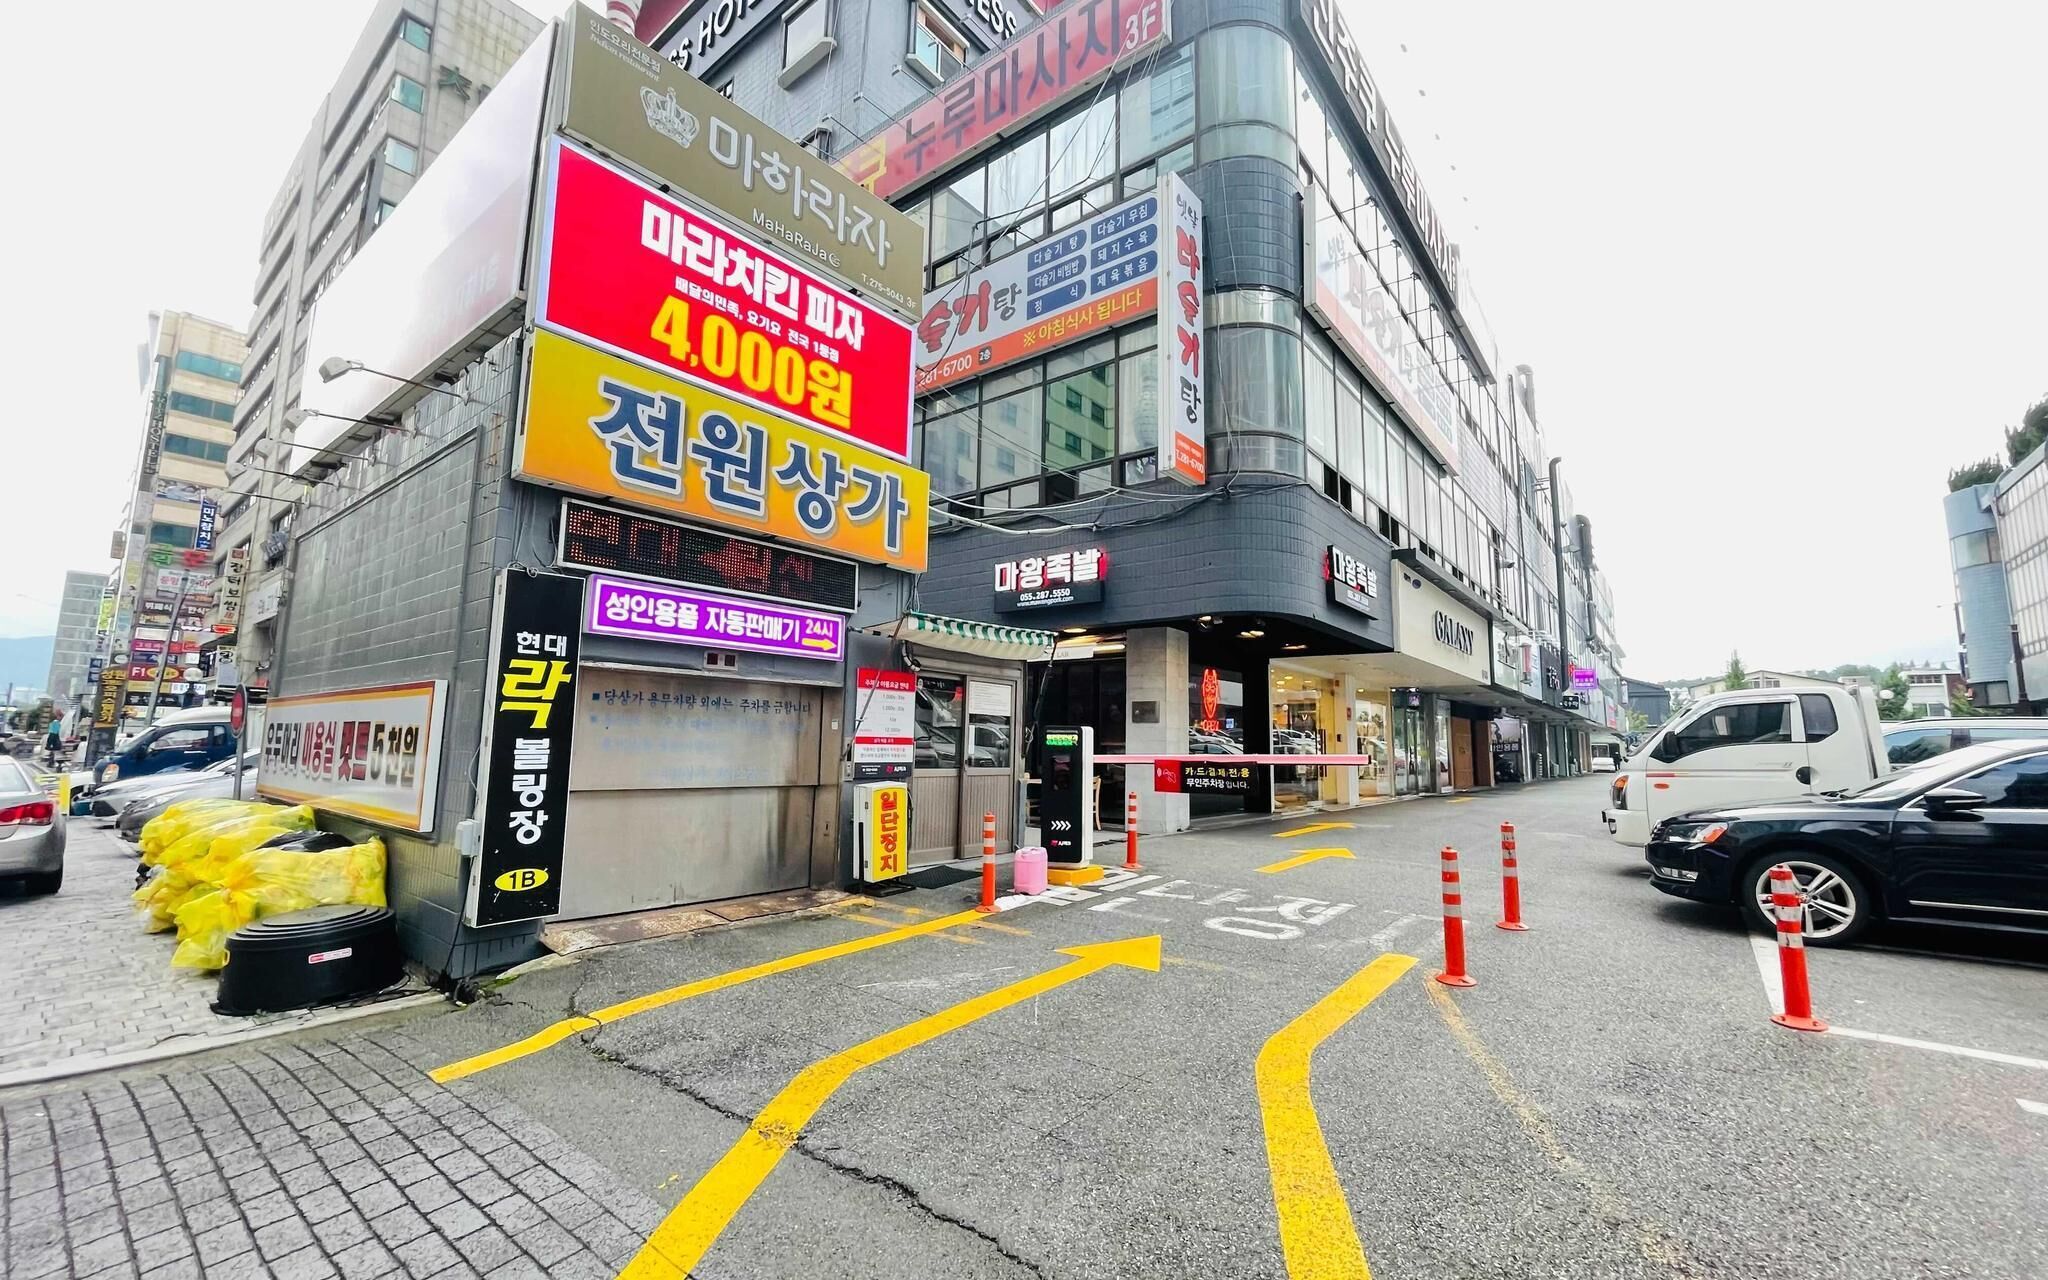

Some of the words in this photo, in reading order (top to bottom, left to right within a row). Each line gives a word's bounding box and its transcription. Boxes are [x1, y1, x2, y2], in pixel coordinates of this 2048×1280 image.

[590, 19, 661, 73] 인도요리전문점
[1125, 3, 1157, 50] 3F
[618, 52, 660, 81] restaurant
[708, 114, 894, 269] 마하라자
[752, 208, 827, 261] MaHaRaJa
[1097, 214, 1127, 236] 다슬기
[1127, 203, 1149, 226] 무침
[640, 199, 800, 322] 마라치킨
[805, 284, 865, 352] 피자
[1034, 241, 1063, 264] 다슬기
[1056, 261, 1080, 283] 비빔밥
[746, 309, 782, 337] 요기요
[1039, 306, 1094, 339] 아침식사
[1096, 288, 1143, 318] 됩니다
[650, 294, 853, 430] 4,000원
[588, 376, 910, 554] 전원상가
[994, 548, 1102, 592] 마왕족발
[1019, 588, 1071, 602] 055.287.5550
[1332, 546, 1378, 598] 마왕족발
[605, 591, 699, 630] 성인용품
[704, 607, 800, 643] 자동판매기
[805, 618, 834, 638] 24시
[1434, 610, 1474, 656] GALAXY
[516, 630, 567, 658] 현대
[499, 660, 573, 729] 락
[740, 698, 771, 713] 주차를
[264, 722, 302, 775] 우두머리
[301, 720, 338, 776] 미용실
[370, 722, 419, 788] 5천원
[508, 737, 550, 845] 볼링장
[880, 790, 899, 873] 일단정지
[508, 870, 537, 890] 1B
